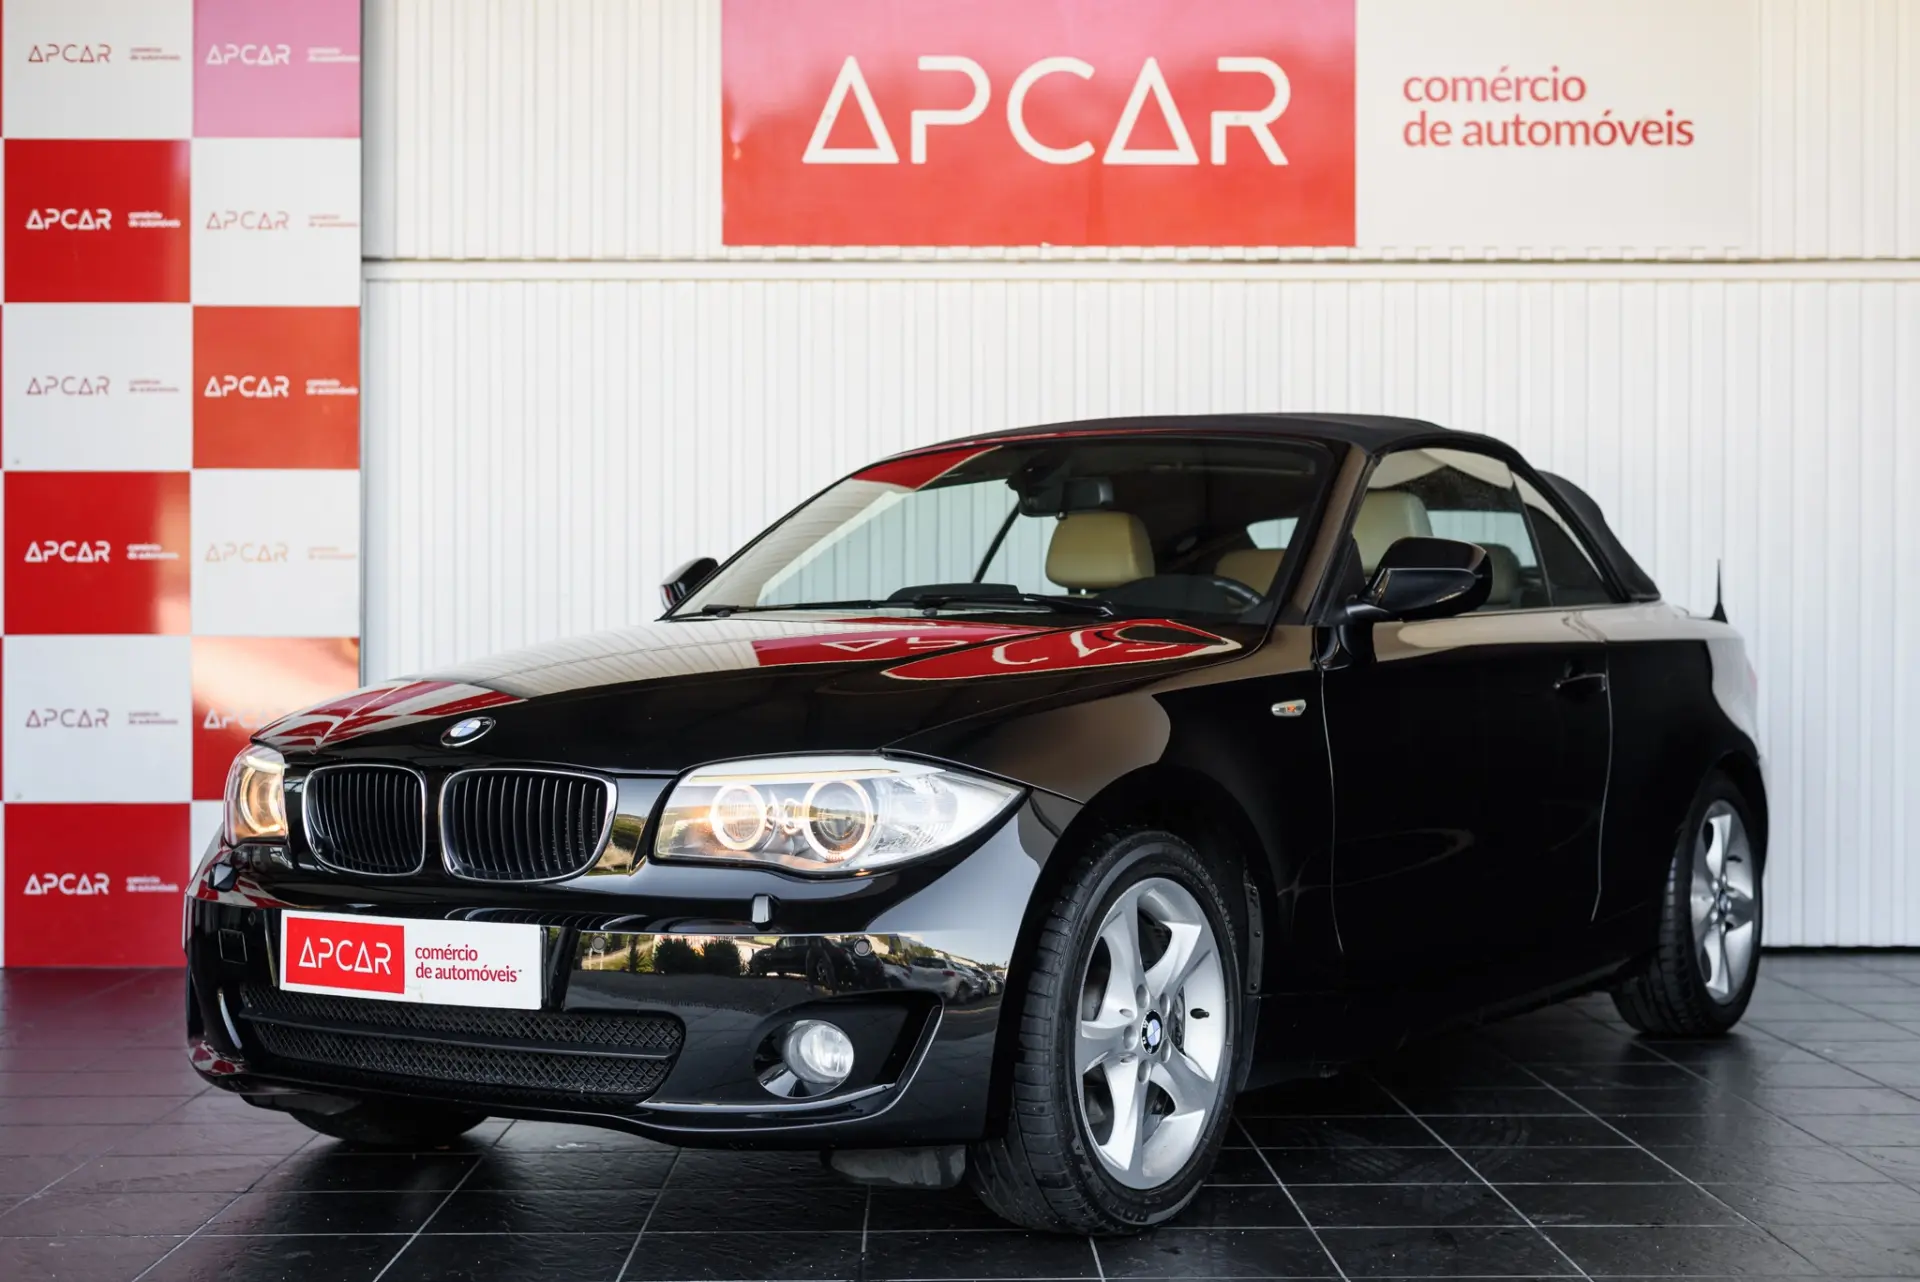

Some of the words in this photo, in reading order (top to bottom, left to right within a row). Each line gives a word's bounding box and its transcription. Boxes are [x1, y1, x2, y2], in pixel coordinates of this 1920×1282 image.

[28, 44, 112, 64] APCAR
[206, 44, 290, 66] APCAR
[1403, 65, 1586, 104] comércio
[802, 55, 1291, 167] APCAR
[1403, 109, 1454, 147] de
[1462, 109, 1695, 147] automóveis
[25, 208, 112, 231] APCAR
[206, 210, 290, 230] APCAR
[26, 376, 111, 396] APCAR
[204, 375, 290, 398] APCAR
[24, 540, 111, 563] APCAR
[25, 708, 110, 729] APCAR
[24, 872, 110, 896] APCAR
[298, 936, 392, 975] APCAR
[414, 943, 478, 962] comércio
[415, 962, 432, 980] de
[434, 964, 518, 983] automóveis
